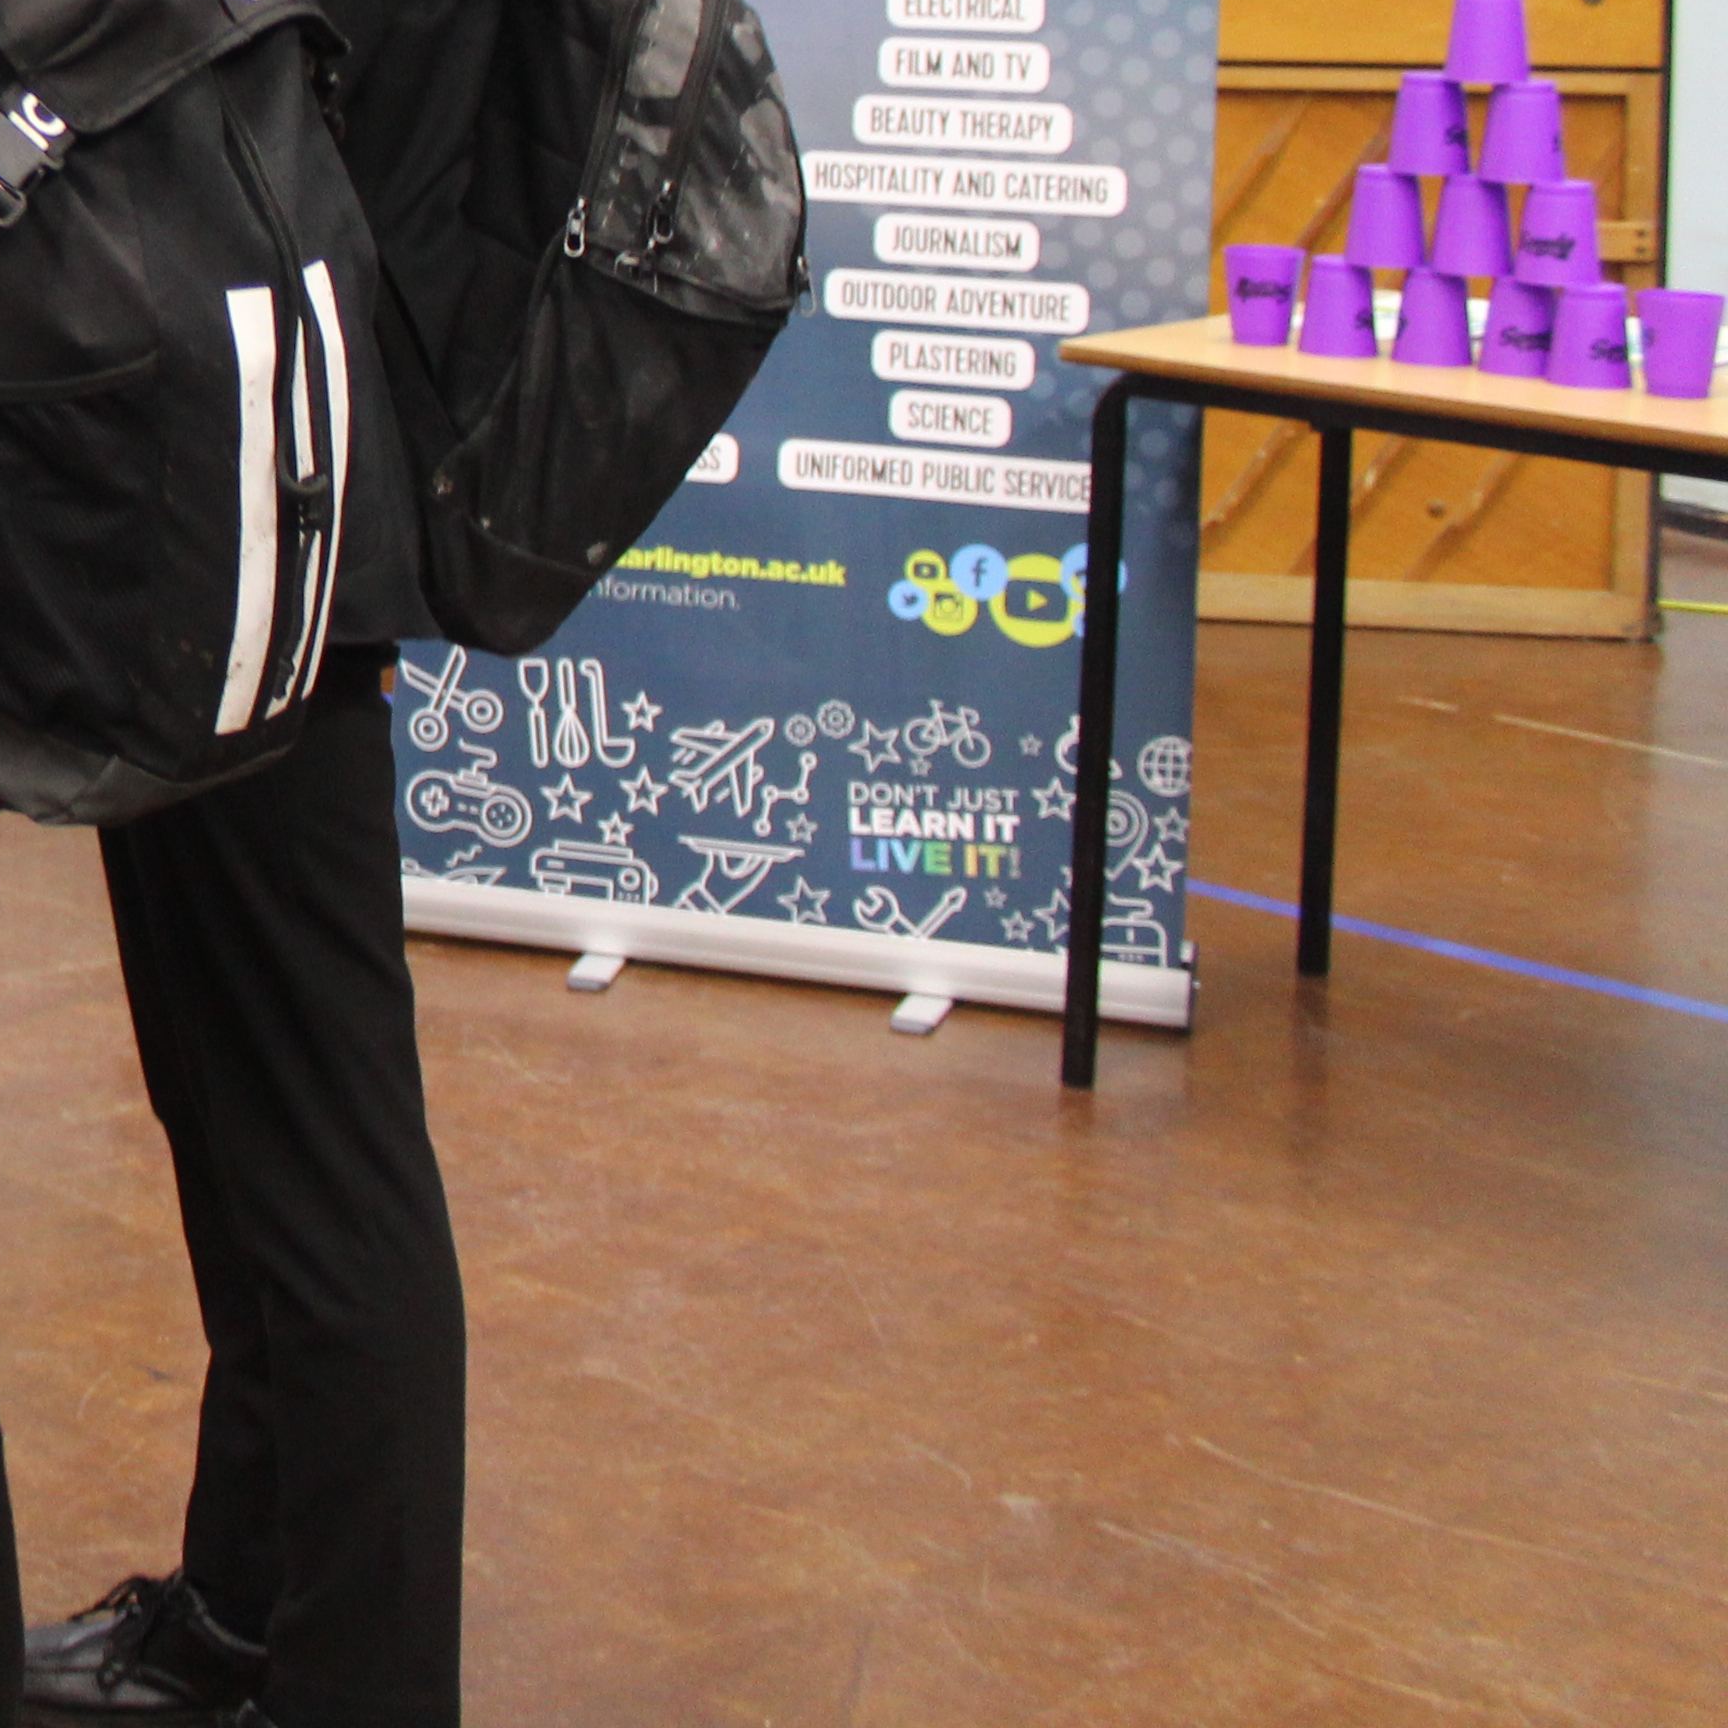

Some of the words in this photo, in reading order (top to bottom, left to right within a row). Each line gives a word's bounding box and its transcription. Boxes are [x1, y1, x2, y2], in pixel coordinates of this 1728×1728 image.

[895, 48, 944, 76] FILM
[952, 51, 994, 79] AND
[1005, 53, 1032, 80] TV
[870, 108, 950, 137] BEAUTY
[960, 111, 1054, 142] THERAPY
[814, 165, 942, 199] HOSPITALITY
[953, 170, 995, 200] AND
[1006, 173, 1109, 205] CATERING
[892, 228, 1023, 259] JOURNALISM
[841, 281, 937, 314] OUTDOOR
[946, 287, 1071, 322] ADVENTURE
[890, 343, 1016, 378] PLASTERING
[908, 404, 994, 435] SCIENCE
[795, 450, 913, 486] UNIFORMED
[921, 458, 995, 495] PUBLIC
[616, 547, 847, 588] arlington.ac.uk
[588, 574, 741, 610] nformation.
[847, 780, 940, 807] DON'T
[946, 786, 1021, 813] JUST
[848, 806, 976, 842] LEARN
[984, 813, 1022, 844] IT
[849, 836, 953, 876] LIVE
[964, 843, 1022, 880] IT!
